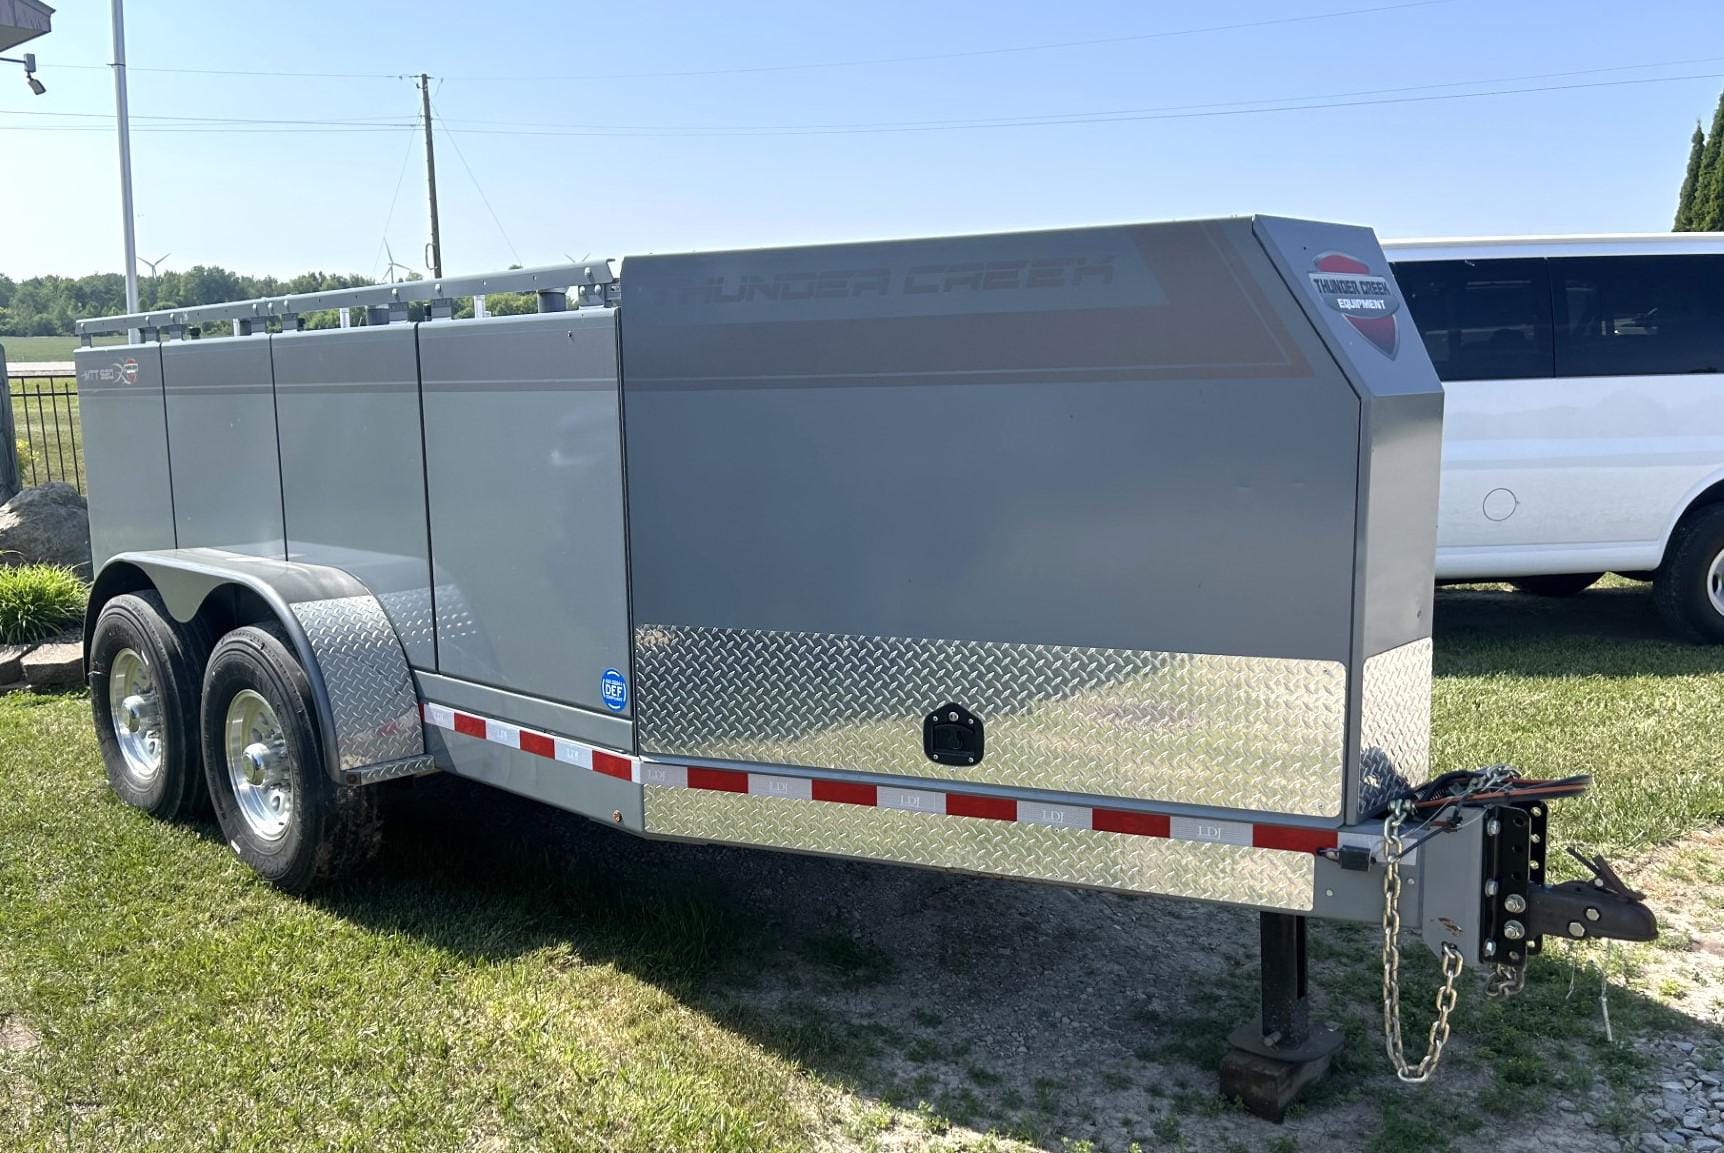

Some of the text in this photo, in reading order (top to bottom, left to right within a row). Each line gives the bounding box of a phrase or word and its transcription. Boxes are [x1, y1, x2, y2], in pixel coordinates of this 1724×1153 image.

[648, 255, 1117, 305] HUNDER CREEK
[1313, 279, 1391, 296] THUNDER CREEK
[1337, 298, 1386, 310] EQUIPMENT
[605, 683, 623, 698] DEF
